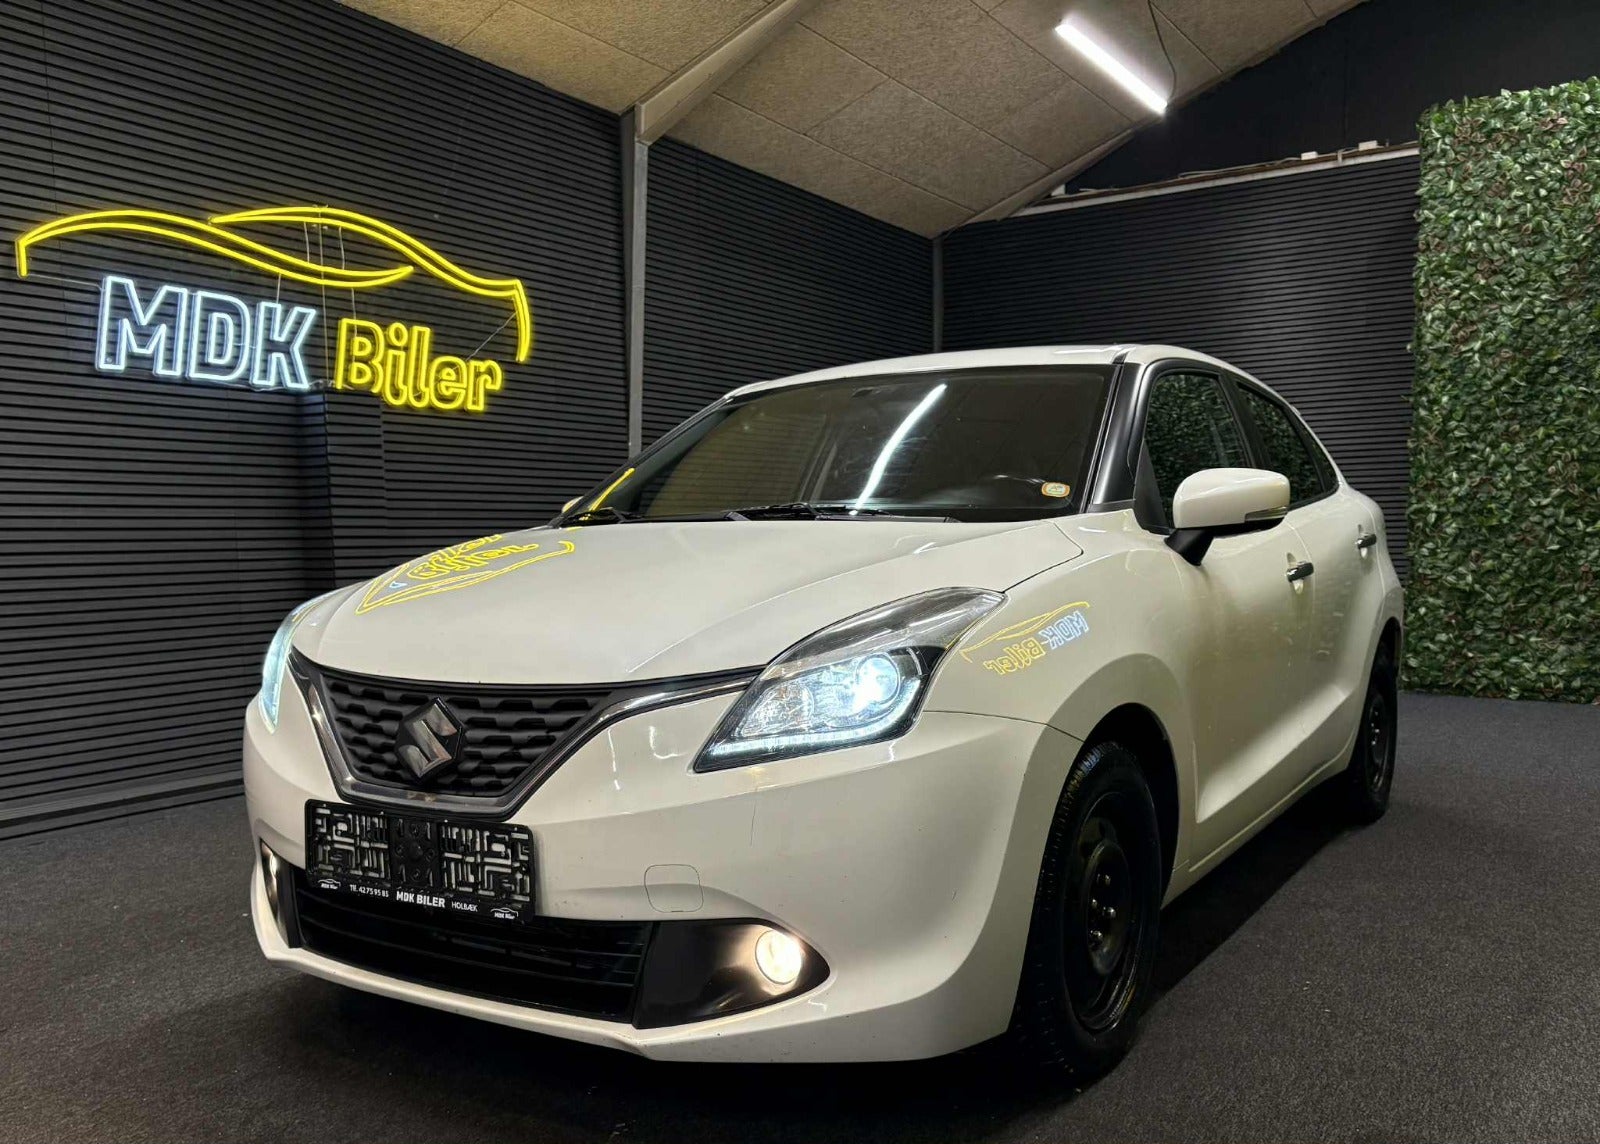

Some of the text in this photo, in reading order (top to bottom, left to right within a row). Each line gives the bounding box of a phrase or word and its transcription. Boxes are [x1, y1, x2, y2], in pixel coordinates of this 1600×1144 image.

[96, 275, 503, 413] MDK Biler
[396, 891, 415, 903] MDK
[416, 895, 446, 908] BILER
